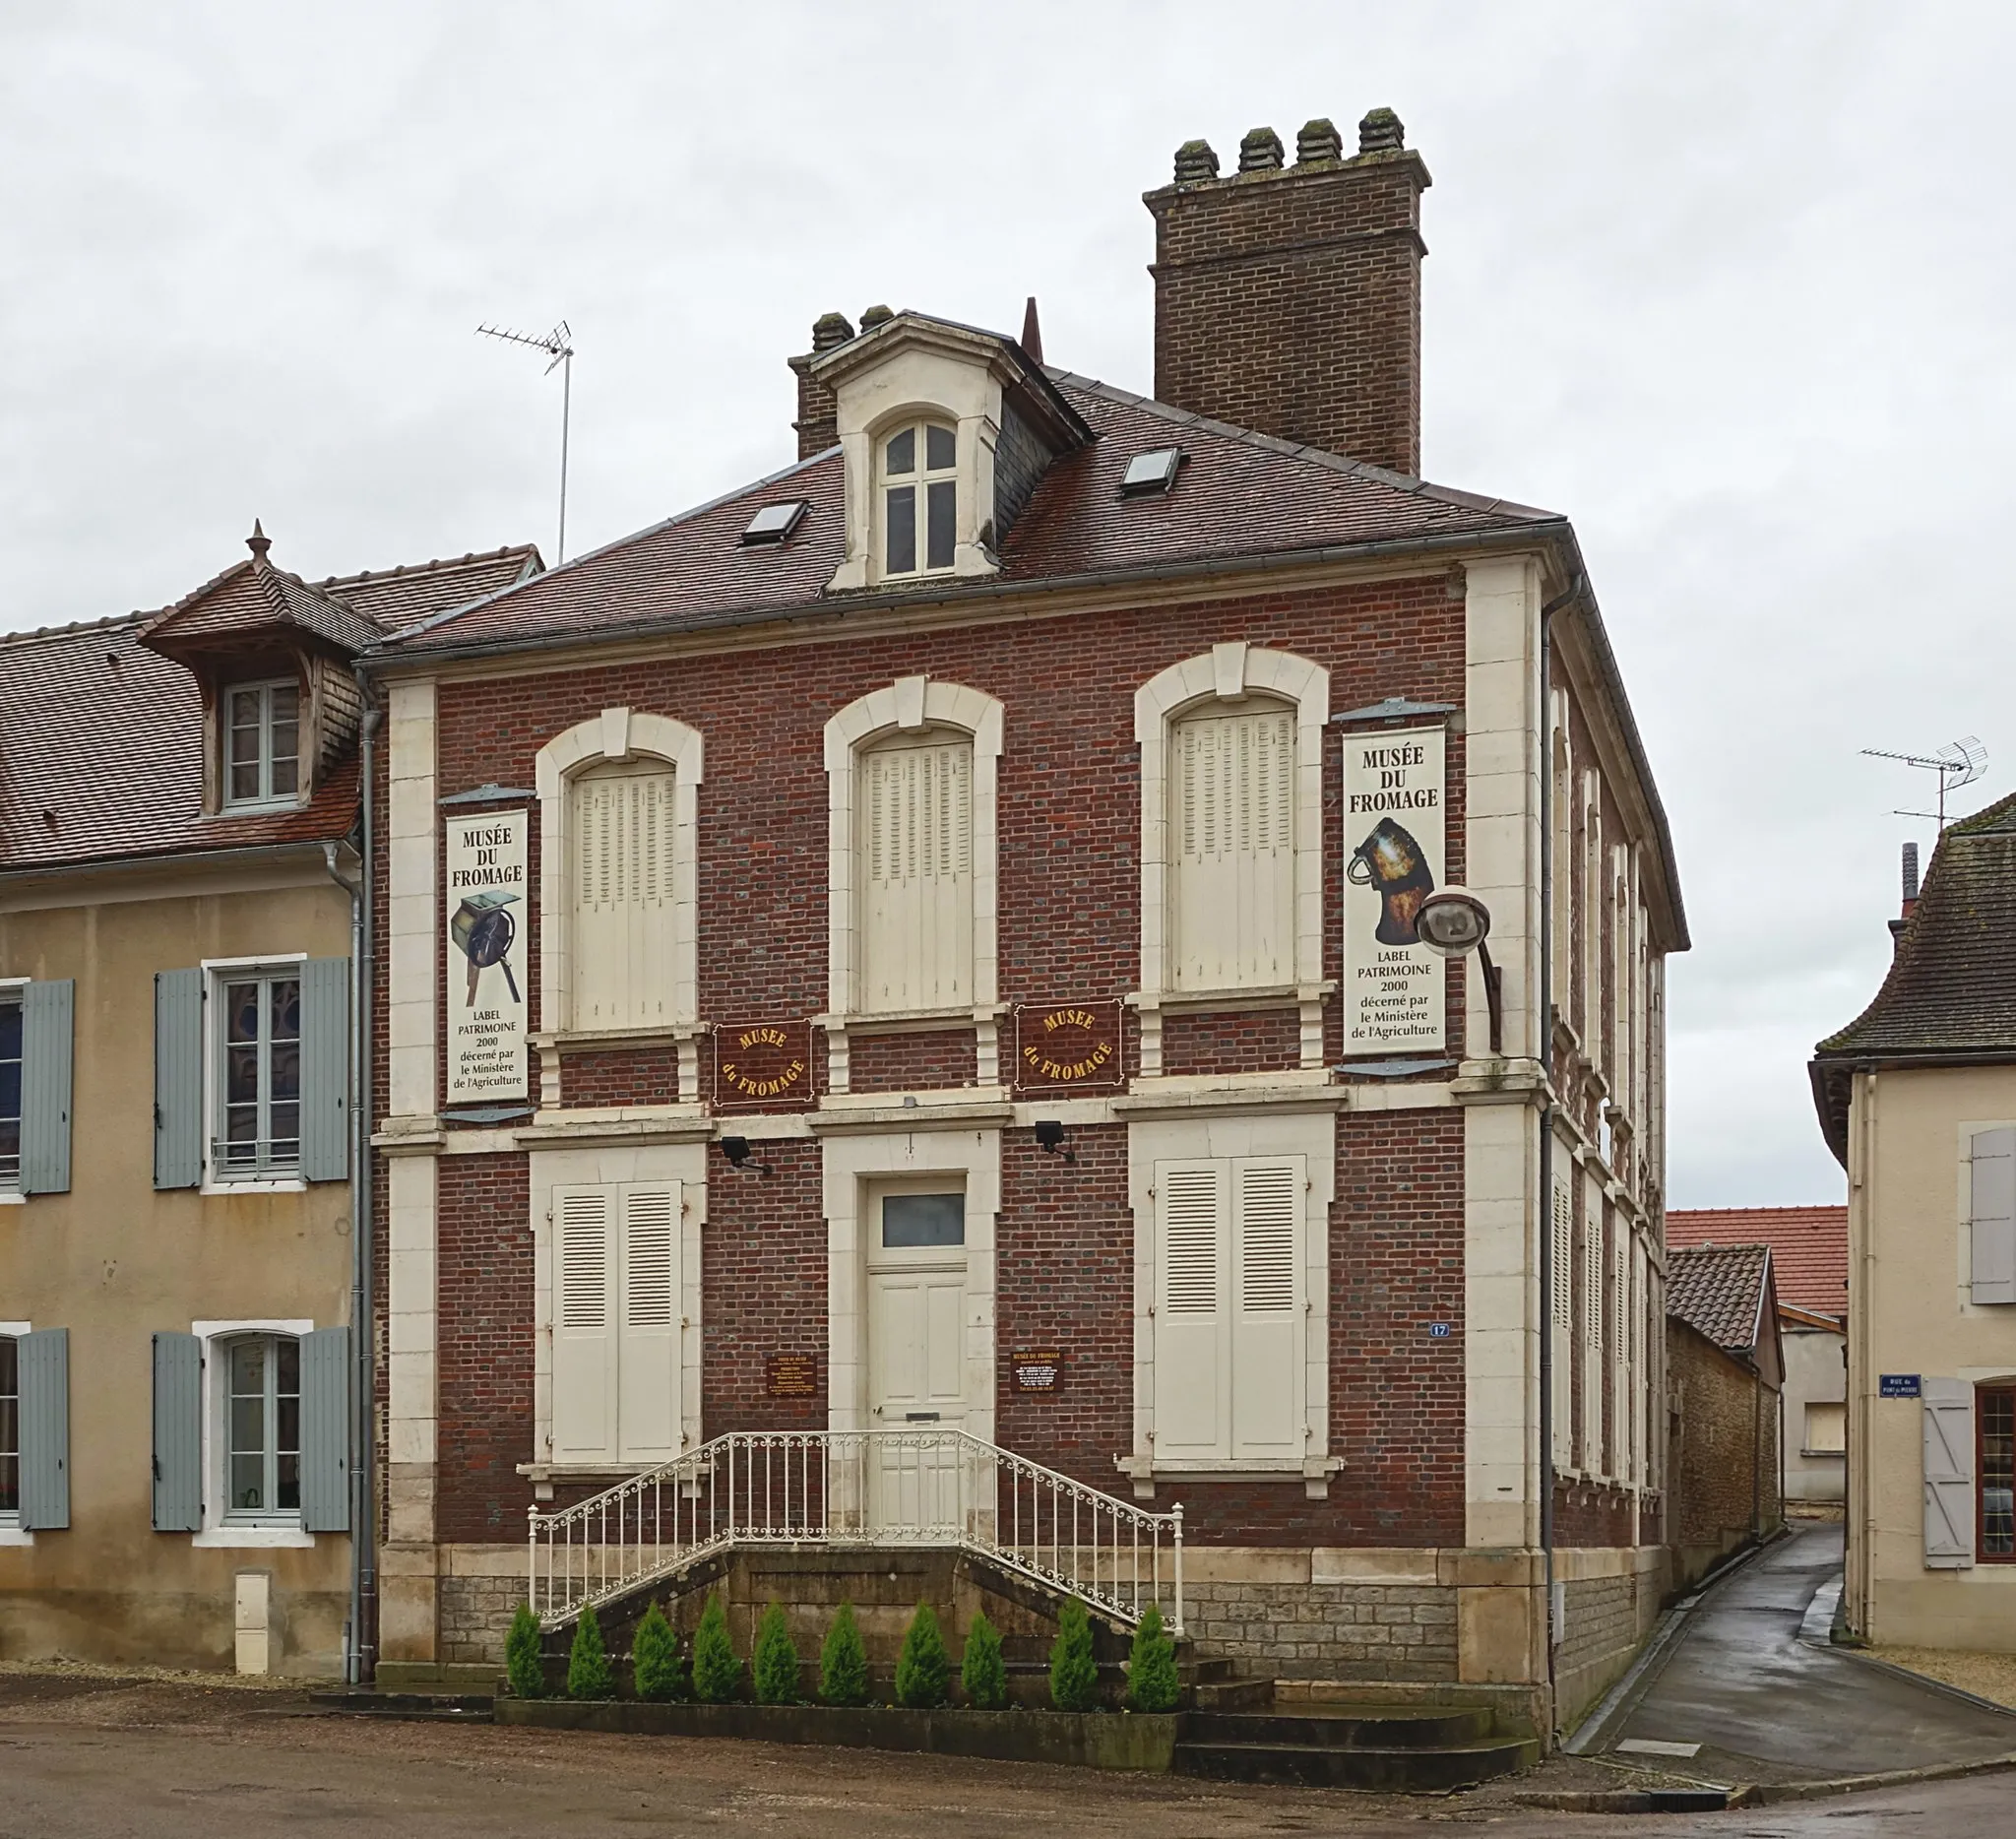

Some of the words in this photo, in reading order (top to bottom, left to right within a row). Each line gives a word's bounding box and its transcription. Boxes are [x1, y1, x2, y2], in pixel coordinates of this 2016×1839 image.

[1361, 740, 1424, 769] MUSÉE
[1379, 769, 1408, 790] DU
[1349, 787, 1439, 814] FROMAGE
[462, 822, 513, 849] MUSÉE
[475, 848, 498, 866] DU
[451, 863, 524, 888] FROMAGE
[1377, 950, 1412, 963] LABEL
[1357, 964, 1432, 979] PATRIMOINE
[1380, 980, 1409, 992] 2000
[1359, 993, 1407, 1008] décerné
[1409, 996, 1429, 1010] par
[472, 1009, 501, 1021] LABEL
[1043, 1009, 1096, 1032] MUSEE
[1360, 1011, 1372, 1024] le
[1373, 1007, 1428, 1023] Ministère
[458, 1021, 517, 1036] PATRIMOINE
[1351, 1026, 1366, 1040] de
[1368, 1023, 1438, 1042] l'Agriculture
[475, 1037, 499, 1048] 2000
[738, 1028, 788, 1049] MUSEE
[460, 1048, 497, 1061] décerné
[498, 1049, 515, 1062] par
[1024, 1046, 1040, 1065] du
[1040, 1042, 1112, 1080] FROMAGE
[461, 1063, 471, 1075] le
[472, 1059, 515, 1074] Ministère
[453, 1077, 466, 1089] de
[467, 1073, 523, 1092] l'Agriculture
[722, 1063, 737, 1083] du
[737, 1059, 805, 1097] FROMAGE
[1434, 1326, 1446, 1335] 17
